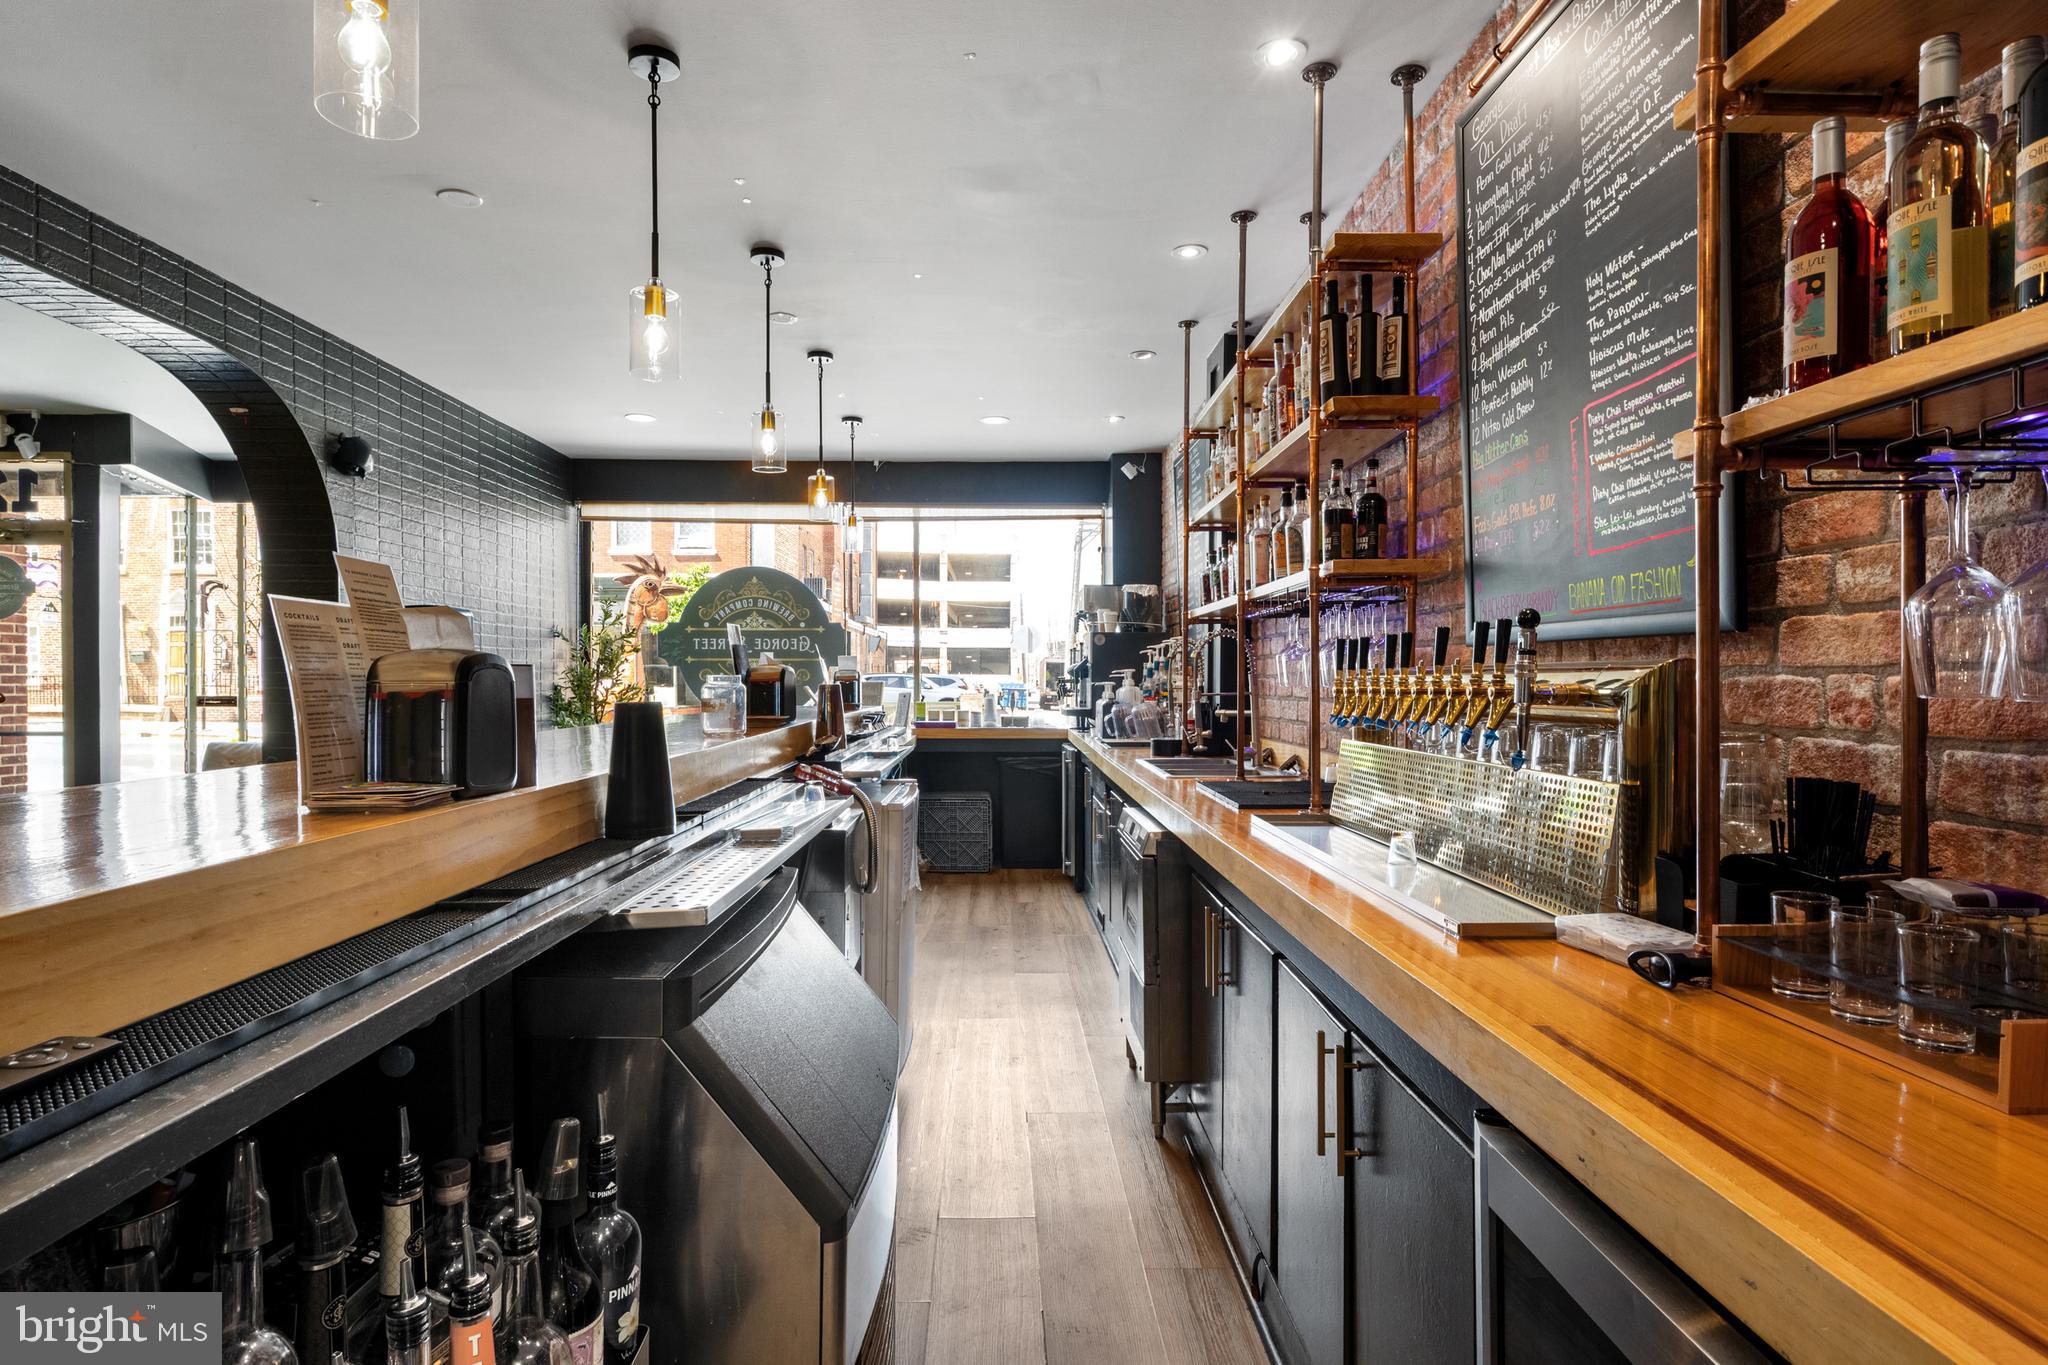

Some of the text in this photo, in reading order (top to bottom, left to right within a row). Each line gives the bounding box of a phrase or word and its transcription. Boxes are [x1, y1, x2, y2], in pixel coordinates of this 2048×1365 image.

[1624, 0, 1662, 41] Martin
[1479, 141, 1495, 166] On
[1476, 171, 1494, 195] Penn
[1495, 147, 1512, 174] Gold
[1583, 171, 1628, 216] The Lydia
[1477, 215, 1494, 240] Penn
[1478, 275, 1503, 304] Joose
[1525, 239, 1545, 265] IPA
[1585, 272, 1603, 292] Holy
[1479, 326, 1497, 349] Penn
[1500, 309, 1515, 332] Pils
[1586, 316, 1605, 332] The
[1481, 378, 1498, 397] Penn
[1497, 357, 1528, 384] Weizen
[1510, 374, 1534, 399] Bubbly
[1501, 407, 1516, 429] Cold
[1605, 404, 1622, 419] Chai
[1510, 429, 1529, 451] Cans
[1611, 481, 1625, 494] Chai
[1593, 515, 1609, 530] She
[1630, 563, 1681, 604] FASHION
[283, 612, 320, 622] COCKTAILS
